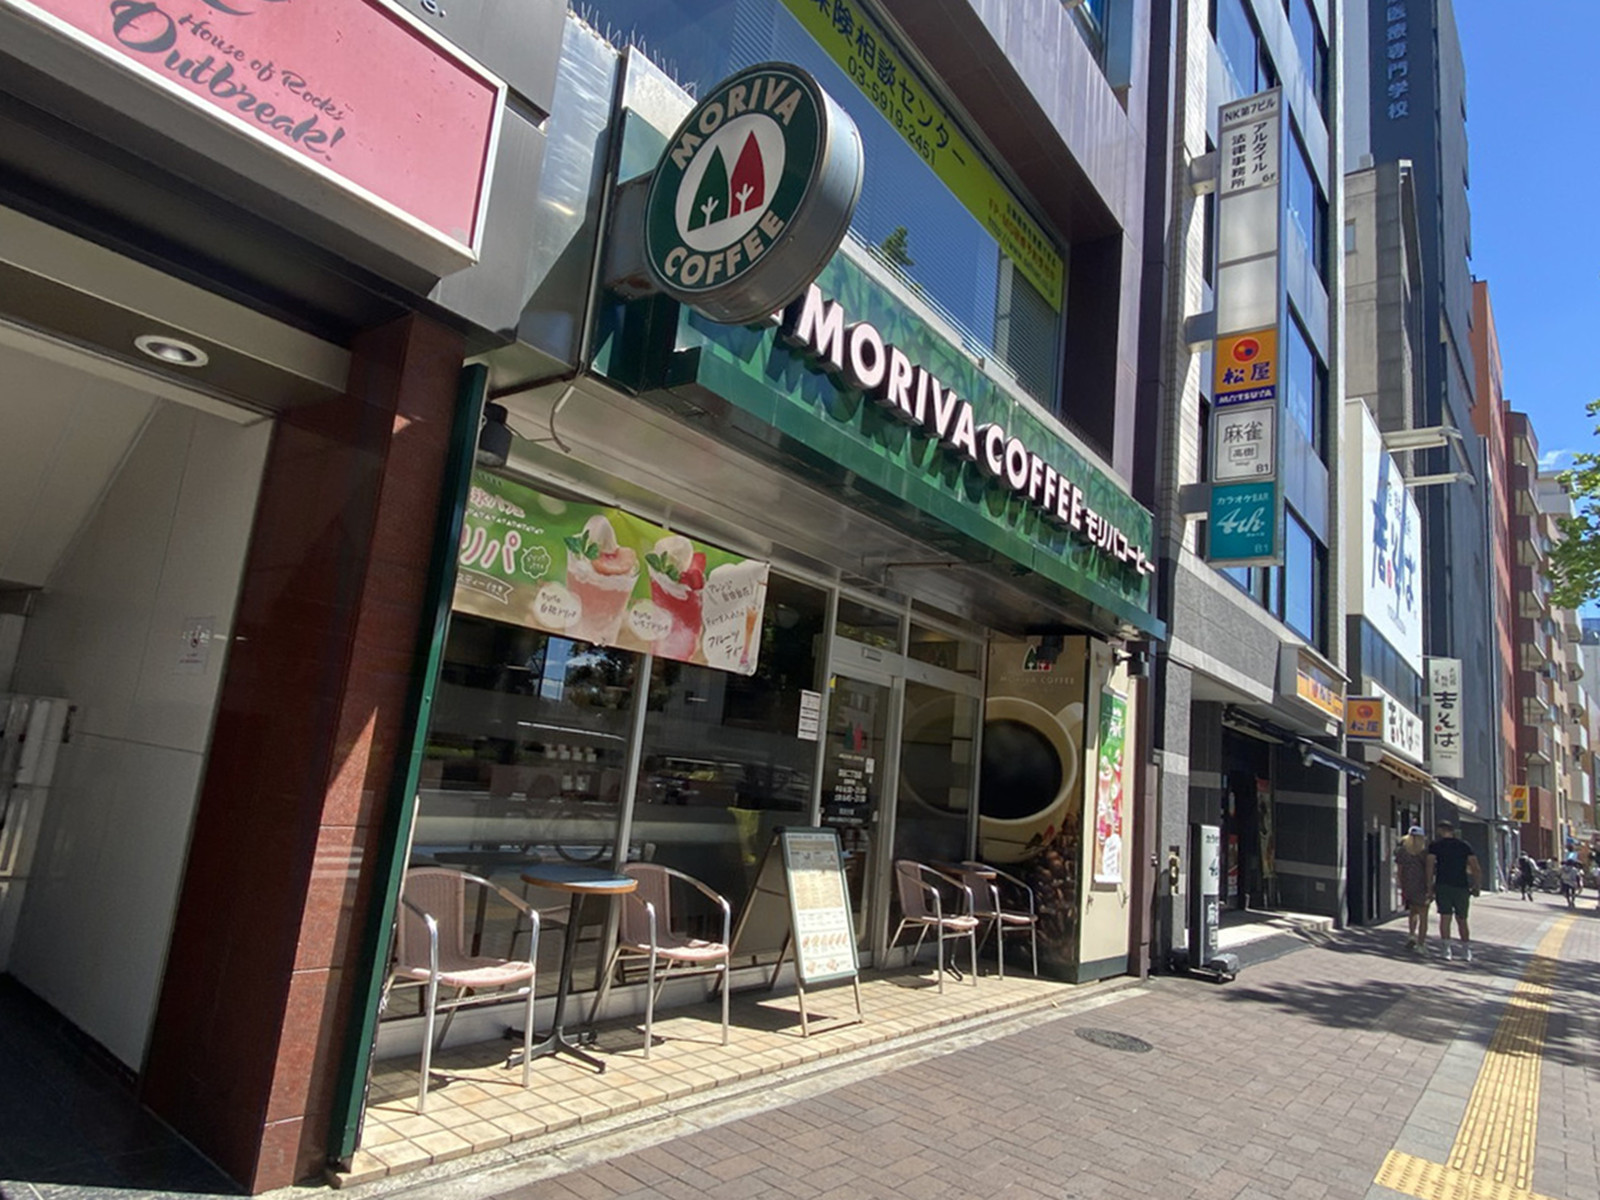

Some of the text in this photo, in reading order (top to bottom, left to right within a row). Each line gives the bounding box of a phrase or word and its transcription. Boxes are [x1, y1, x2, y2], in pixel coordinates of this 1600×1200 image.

[109, 0, 346, 162] Outbreak!
[178, 13, 347, 121] House of Rocks
[670, 77, 802, 171] MORIVA
[1252, 121, 1268, 174] アルタイル
[1230, 134, 1247, 190] 法律事務所
[663, 210, 785, 286] COFFEE
[1222, 361, 1271, 385] 松屋
[797, 282, 1156, 575] MORIVA COFFEE モリバコーヒー
[1224, 421, 1263, 444] 麻雀
[1256, 463, 1269, 472] B1
[1433, 692, 1460, 748] 吉そば
